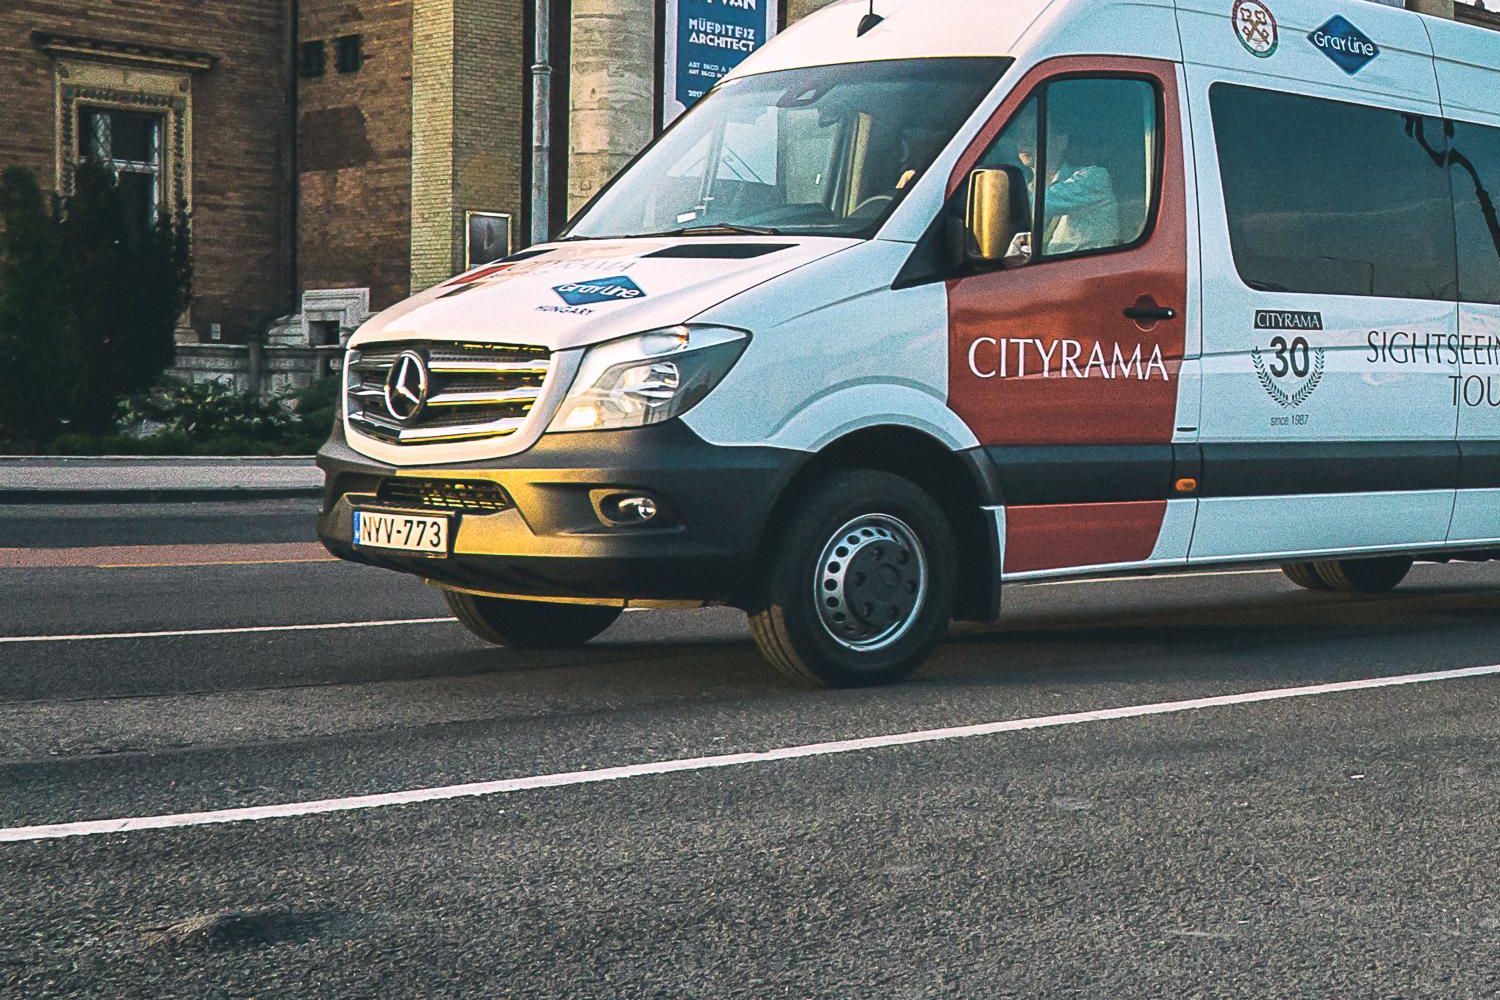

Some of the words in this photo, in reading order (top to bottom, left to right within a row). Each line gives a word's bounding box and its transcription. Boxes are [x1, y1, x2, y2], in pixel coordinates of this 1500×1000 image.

[688, 31, 755, 52] ARCHITECT
[534, 305, 597, 317] HUNGARY
[1257, 312, 1320, 328] CITYRAMA
[968, 337, 1169, 381] CITYRAMA
[1269, 336, 1310, 378] 30
[1270, 415, 1289, 426] since
[1291, 414, 1309, 426] 1987
[362, 516, 441, 548] NYV-773
